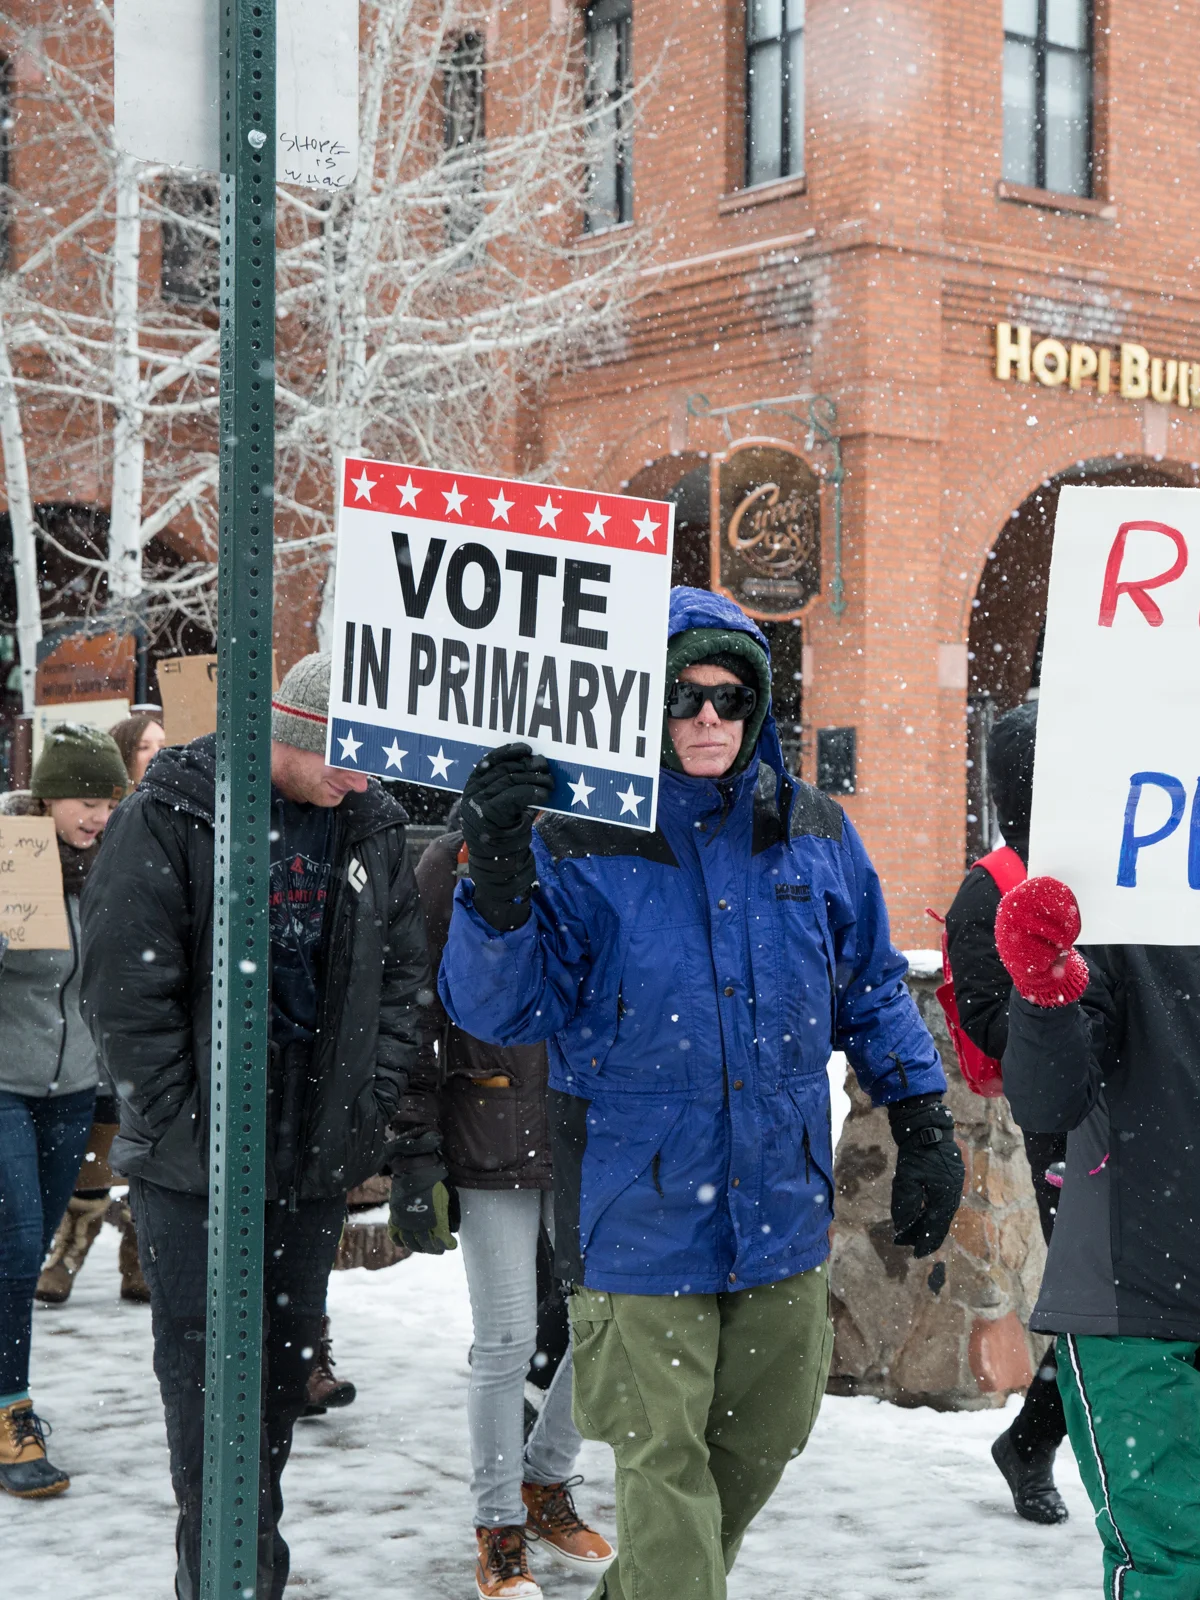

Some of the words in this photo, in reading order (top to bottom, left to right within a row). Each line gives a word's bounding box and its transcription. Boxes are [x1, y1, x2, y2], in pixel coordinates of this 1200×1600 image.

[391, 531, 611, 650] VOTE
[342, 621, 391, 710] IN
[407, 632, 651, 758] PRIMARY!
